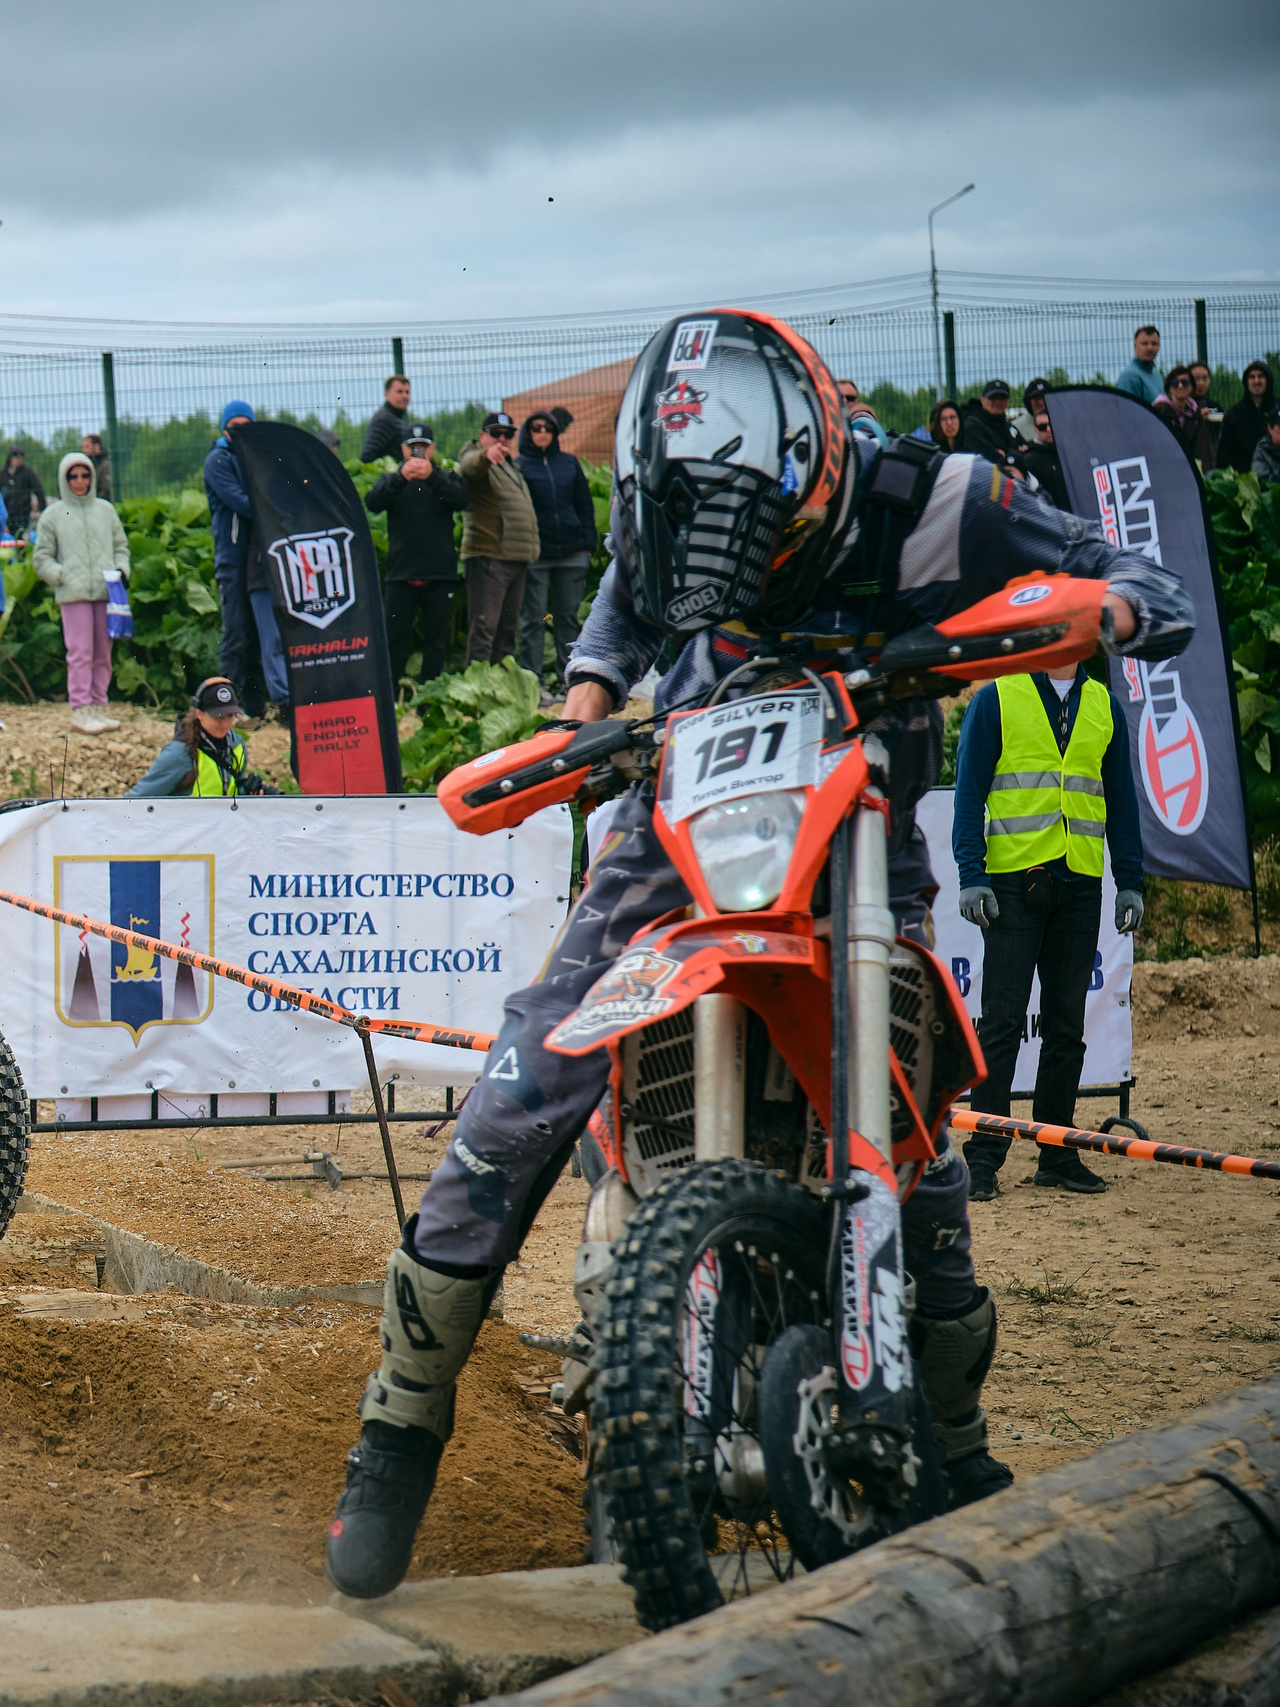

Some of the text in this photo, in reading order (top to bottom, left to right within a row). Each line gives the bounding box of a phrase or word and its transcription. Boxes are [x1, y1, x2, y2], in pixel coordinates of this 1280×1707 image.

[669, 588, 718, 623] SHOEI
[304, 726, 368, 742] ENDURO
[313, 716, 356, 729] HARD
[314, 739, 360, 753] RALLY
[694, 721, 789, 785] 191
[691, 773, 784, 804] Титов Виктор
[248, 872, 515, 899] МИНИСТЕРСТВО
[248, 911, 379, 937] СПОРТА
[247, 942, 502, 975] САХАЛИНСКОЙ
[872, 1266, 904, 1394] KTM
